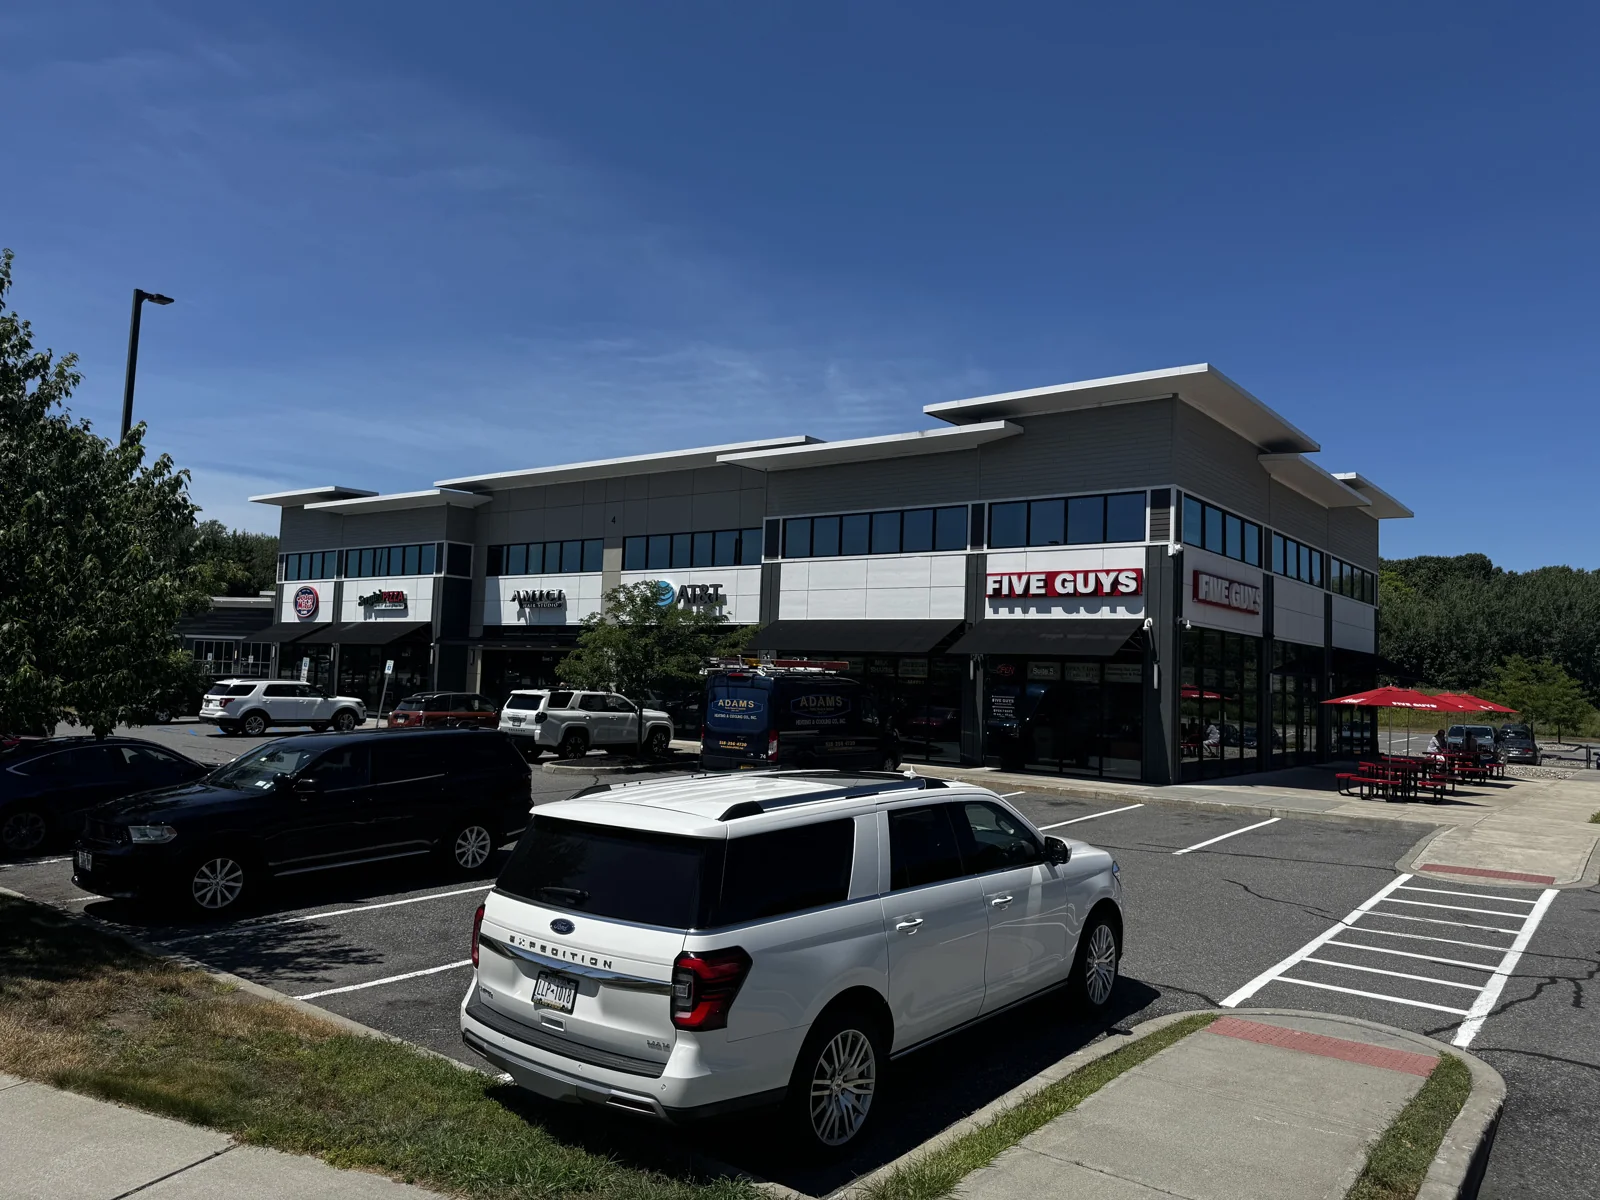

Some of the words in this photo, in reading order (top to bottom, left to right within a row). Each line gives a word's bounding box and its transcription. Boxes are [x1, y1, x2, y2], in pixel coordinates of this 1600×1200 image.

[987, 573, 1046, 596] FIVE
[1054, 570, 1138, 595] GUYS
[382, 591, 404, 603] PIZZA
[509, 588, 564, 606] AMICI
[676, 584, 723, 604] AT&T
[1198, 574, 1229, 604] FIVE
[1229, 582, 1261, 611] GUYS
[537, 601, 558, 609] STUDIO
[717, 699, 755, 708] ADAMS
[799, 695, 843, 708] ADAMS
[553, 921, 570, 932] Ford
[509, 935, 612, 969] EXPEDITION
[536, 980, 552, 998] LLP
[554, 984, 573, 1004] 1018
